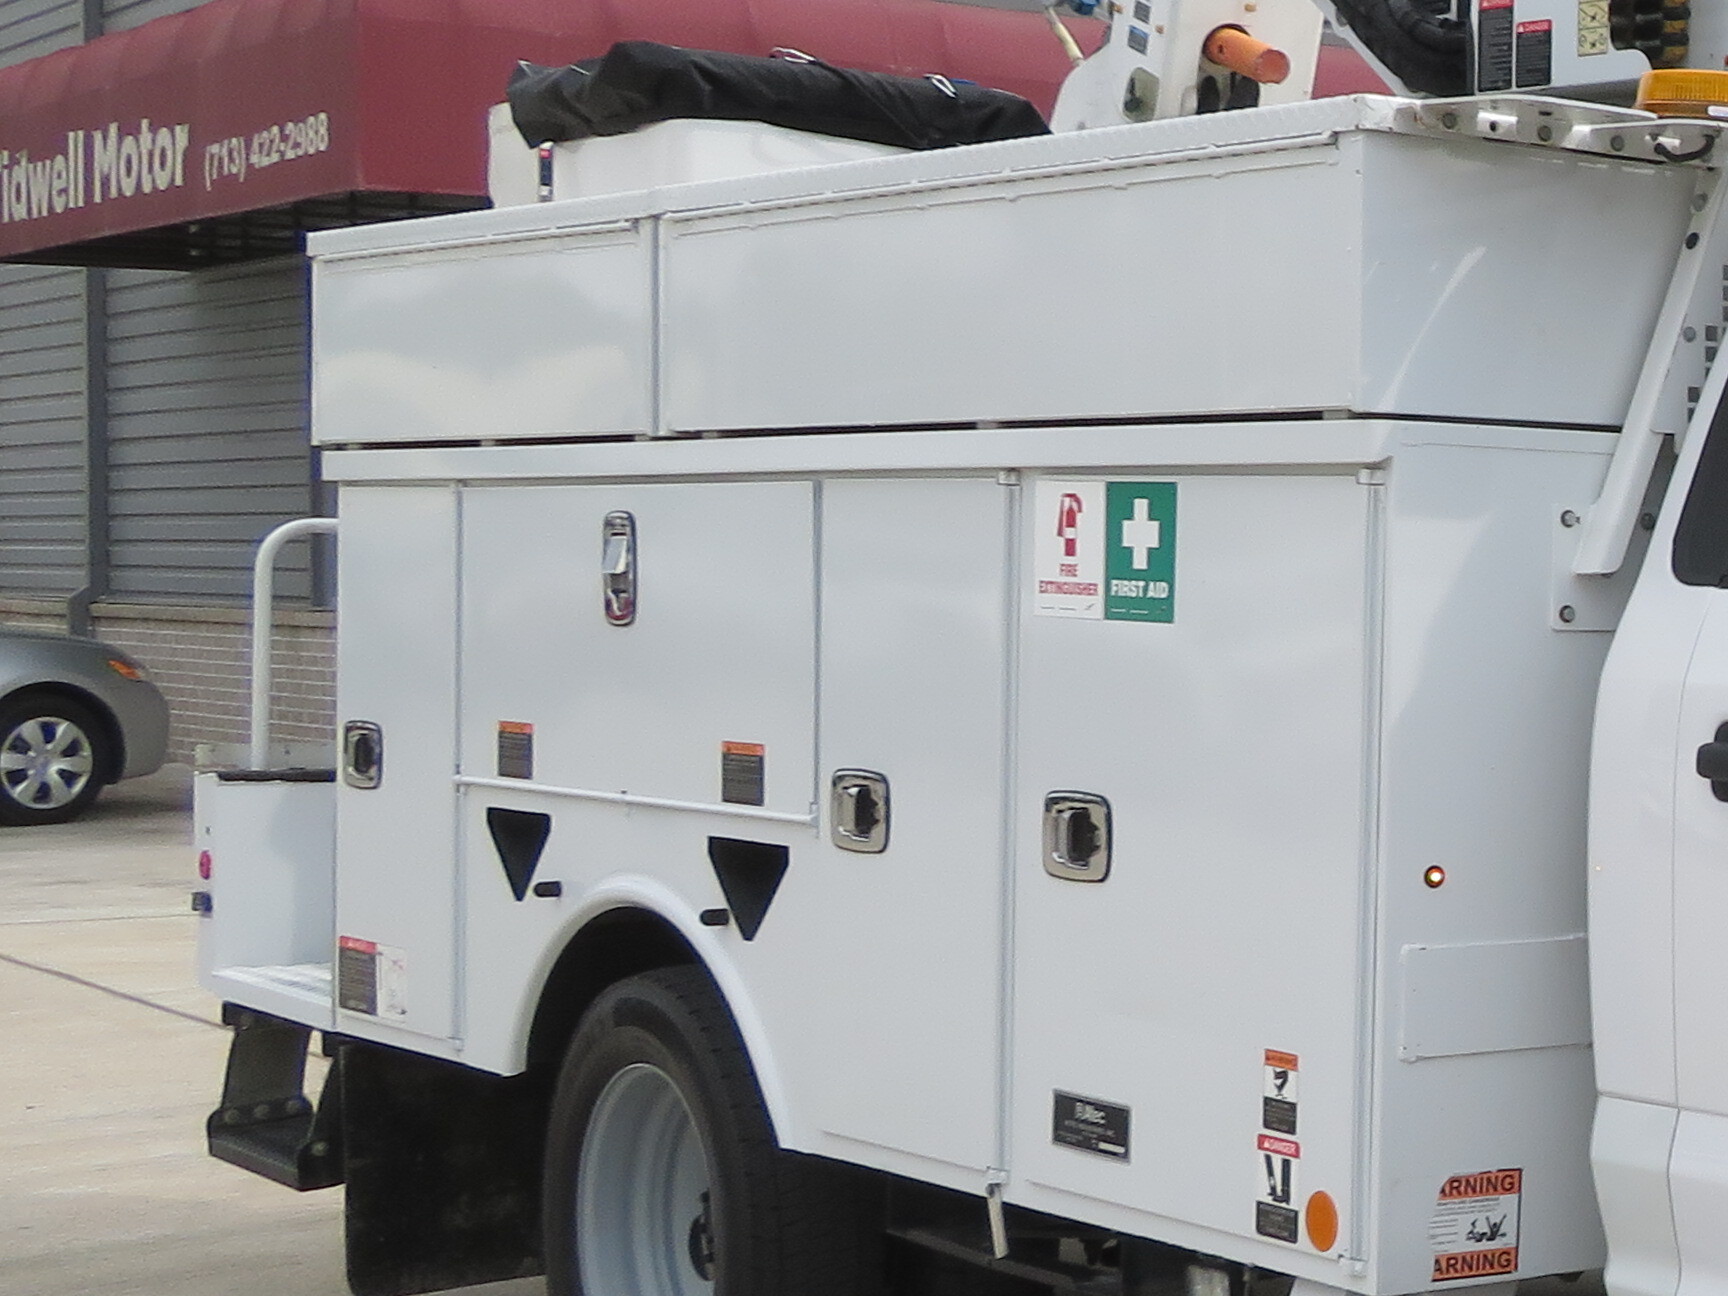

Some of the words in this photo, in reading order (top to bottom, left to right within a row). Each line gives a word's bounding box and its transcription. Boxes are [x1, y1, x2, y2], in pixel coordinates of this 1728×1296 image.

[0, 130, 85, 223] idwell
[93, 119, 190, 203] Motor
[205, 137, 245, 191] (713)
[249, 112, 329, 169] 422-2988
[1110, 579, 1146, 597] FIRST
[1146, 581, 1169, 599] AID
